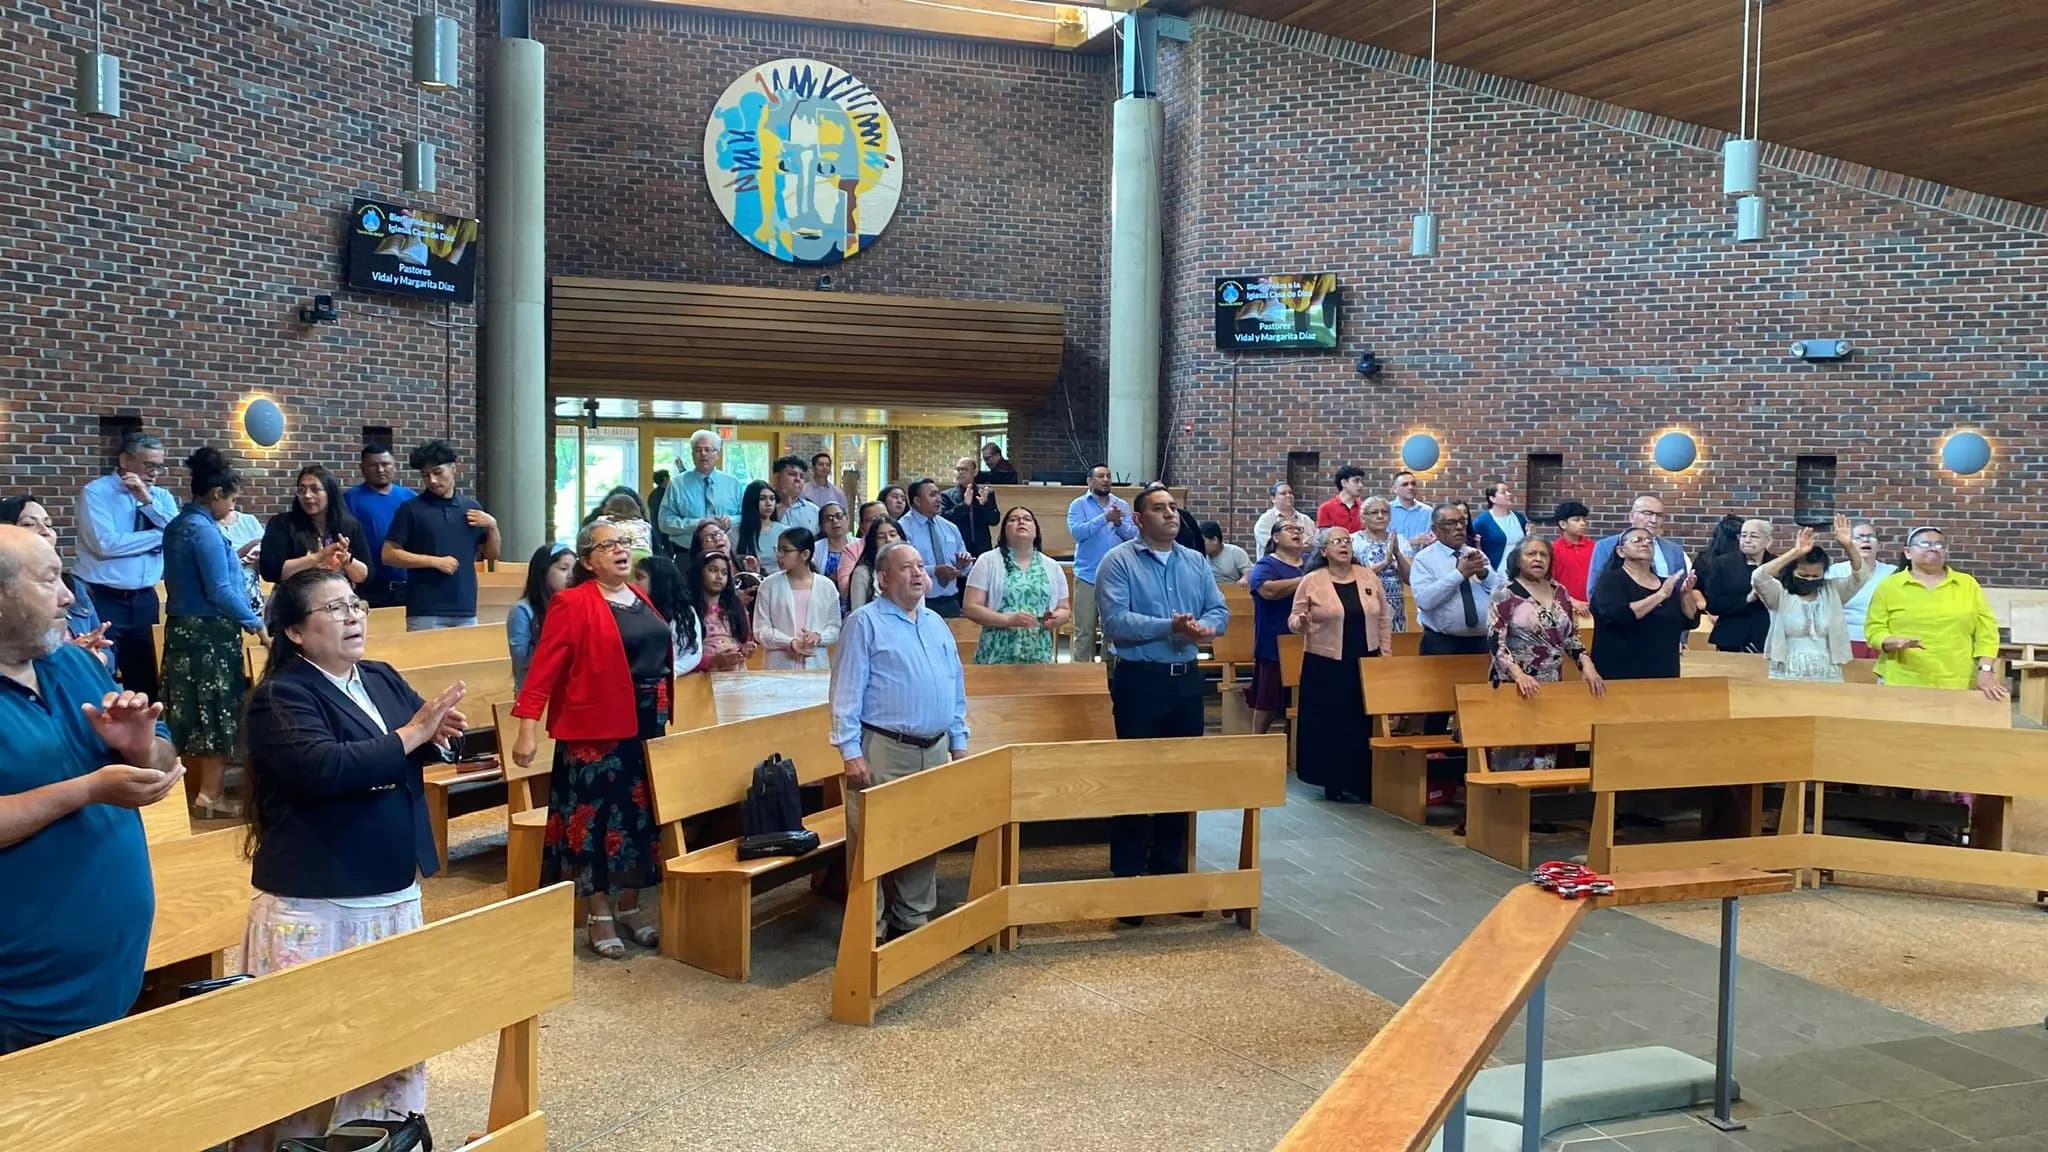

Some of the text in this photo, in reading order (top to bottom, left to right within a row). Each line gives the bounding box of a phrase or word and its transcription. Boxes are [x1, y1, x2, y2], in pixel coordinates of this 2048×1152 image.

[437, 221, 444, 230] la
[430, 231, 439, 239] de
[399, 263, 431, 276] Pastores
[372, 271, 393, 283] Vidal
[400, 275, 437, 289] Margarita
[1287, 290, 1296, 298] de
[1259, 322, 1291, 330] Pastores
[1234, 332, 1254, 341] Vidal
[1260, 332, 1298, 342] Margarita
